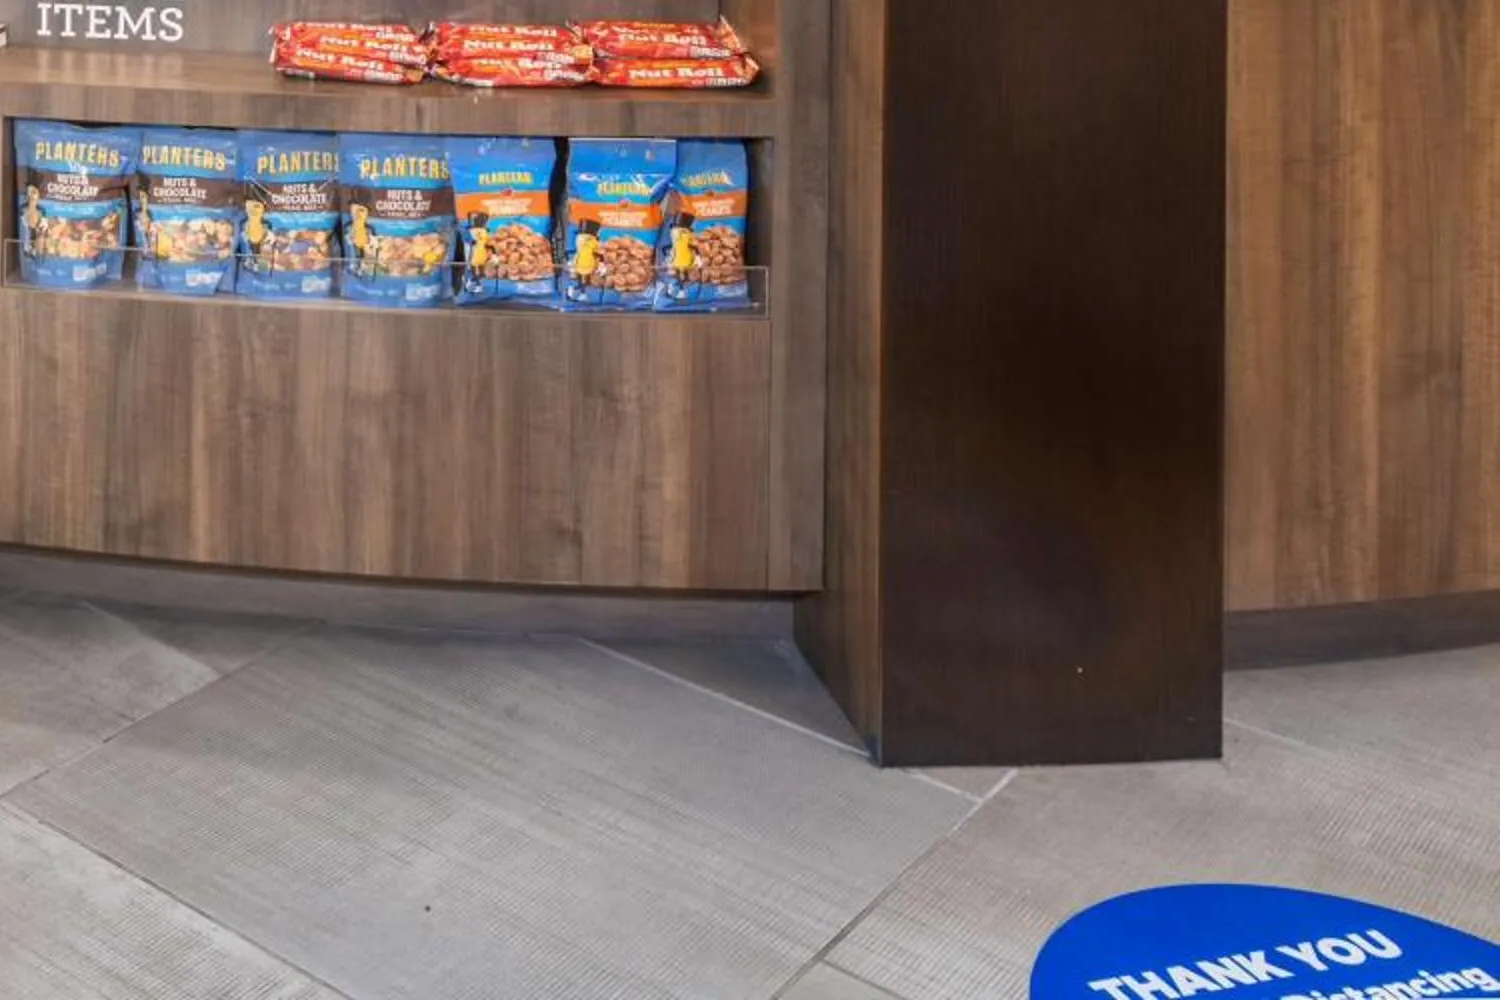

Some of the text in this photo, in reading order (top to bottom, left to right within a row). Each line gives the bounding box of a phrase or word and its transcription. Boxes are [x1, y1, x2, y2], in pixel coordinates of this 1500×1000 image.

[36, 2, 184, 42] ITEMS
[628, 66, 725, 79] Nut Roll
[35, 141, 120, 168] PLANTERS
[143, 145, 226, 171] PLANTERS
[360, 157, 450, 180] PLANTERS
[153, 187, 208, 200] CHOCOLATE
[387, 189, 412, 201] NUTS
[1087, 929, 1403, 1000] THANK YOU
